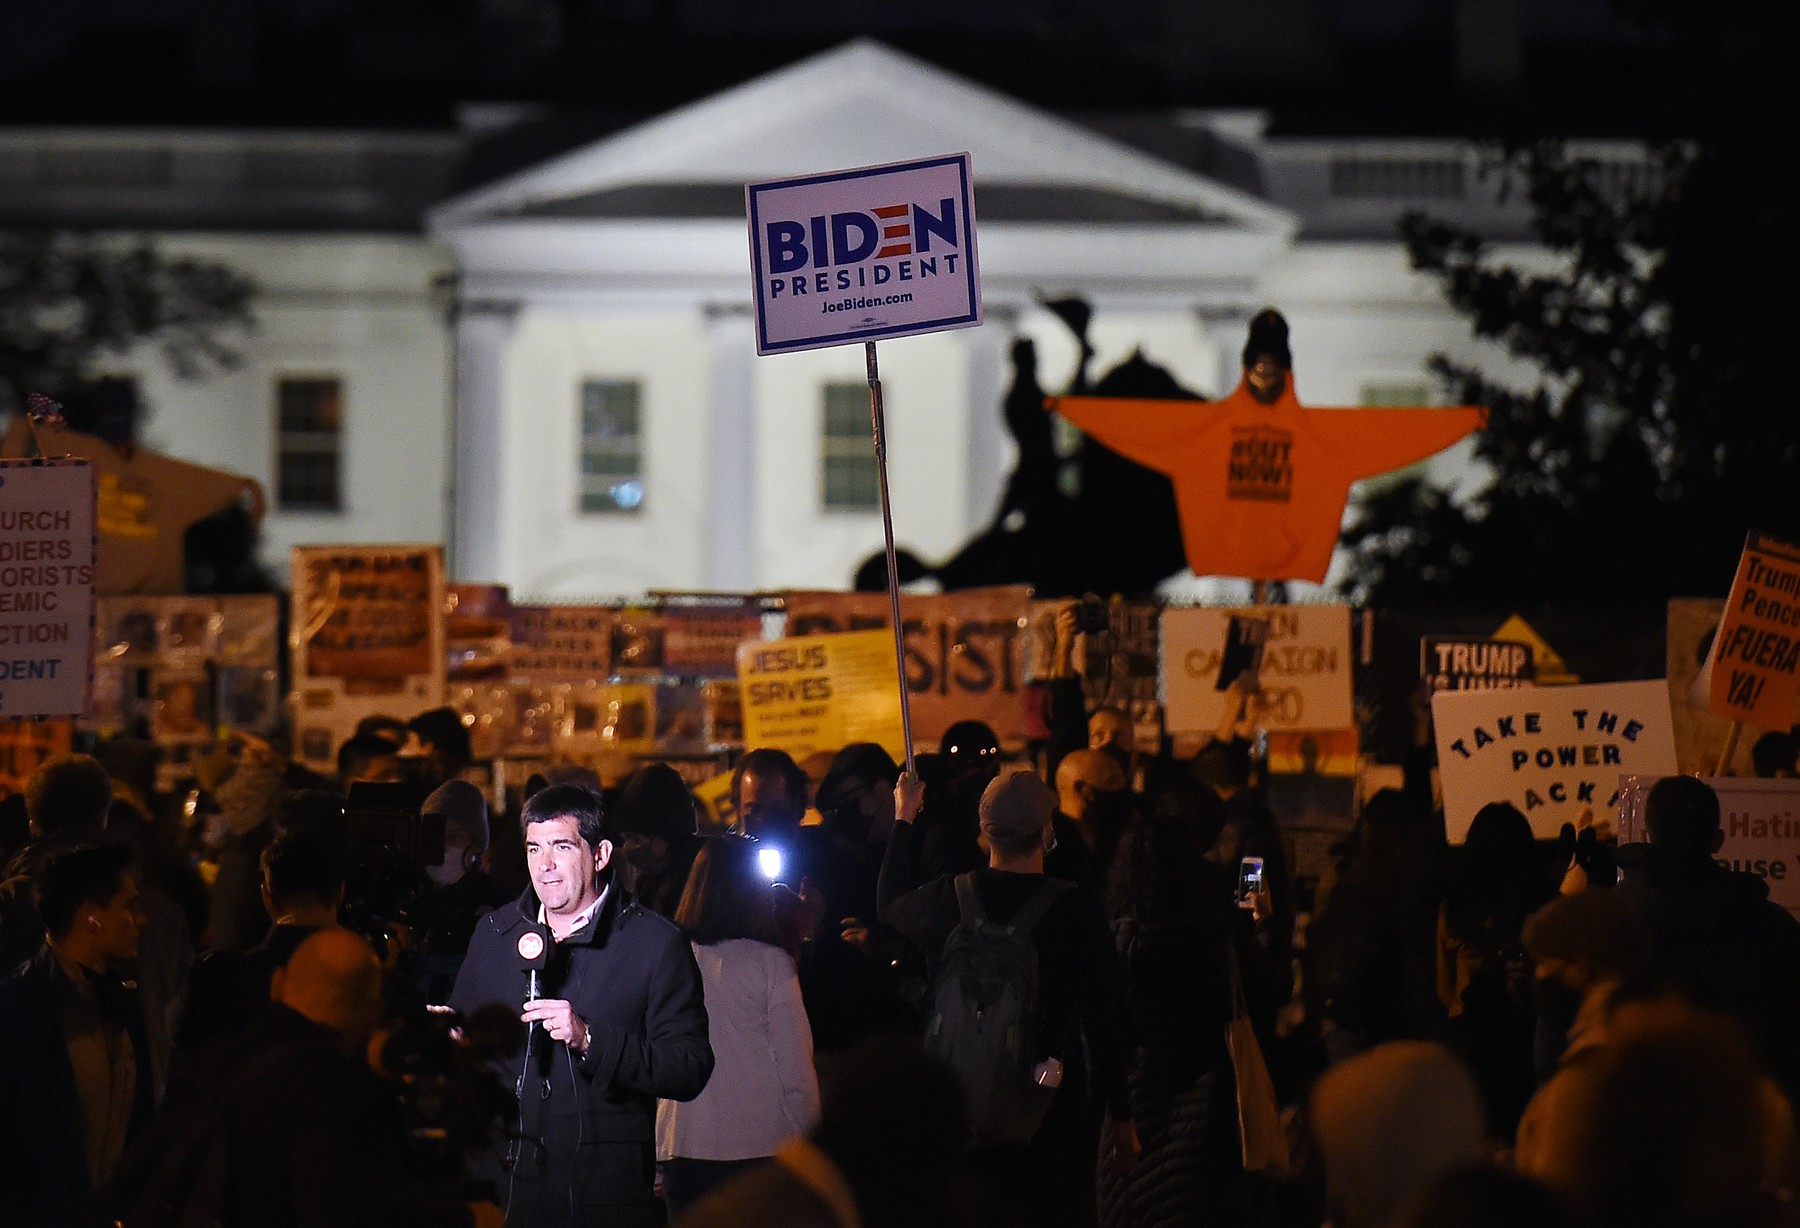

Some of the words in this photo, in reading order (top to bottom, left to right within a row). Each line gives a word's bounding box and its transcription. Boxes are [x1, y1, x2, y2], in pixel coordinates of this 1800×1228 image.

[767, 197, 958, 275] BIDEN
[770, 254, 959, 299] PRESIDENT
[821, 291, 913, 314] JoeBiden.com
[750, 643, 827, 674] JESUS
[1183, 645, 1337, 678] CAAIGN
[1435, 642, 1528, 676] TRUMP
[1727, 669, 1766, 710] YA!
[1450, 712, 1541, 760] TAKE
[1572, 709, 1644, 744] THE
[1512, 745, 1621, 771] POWER
